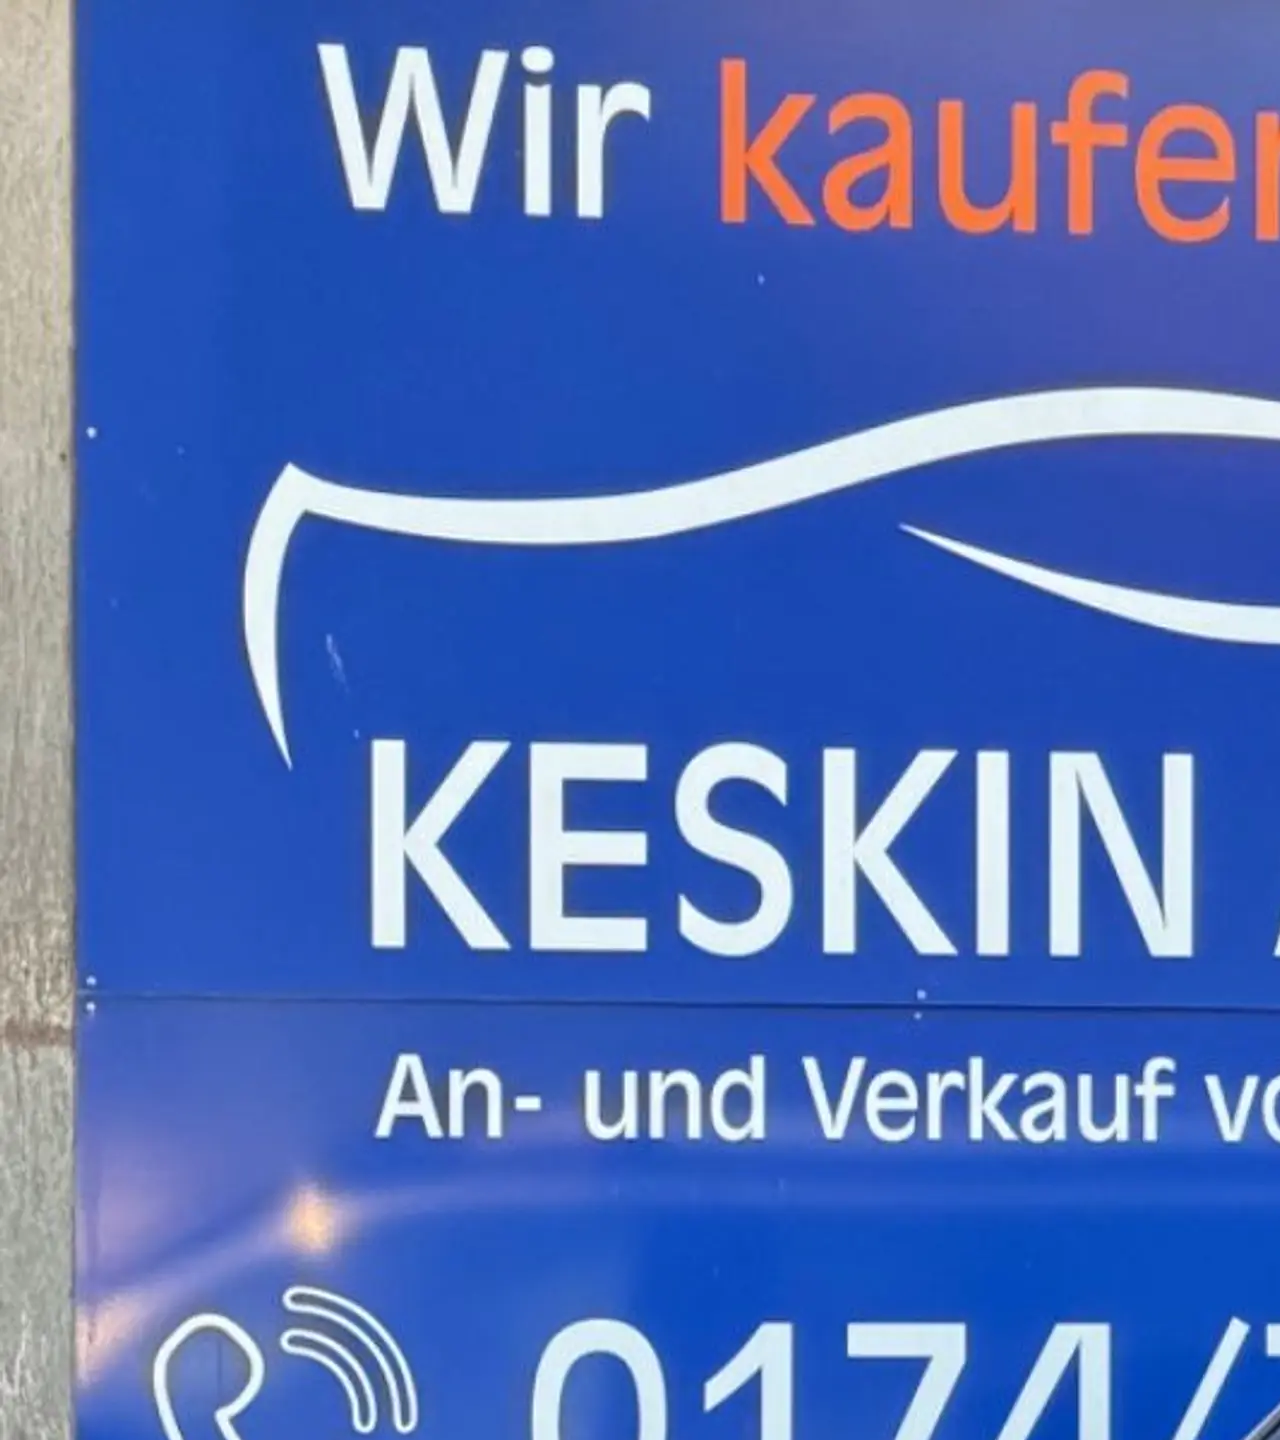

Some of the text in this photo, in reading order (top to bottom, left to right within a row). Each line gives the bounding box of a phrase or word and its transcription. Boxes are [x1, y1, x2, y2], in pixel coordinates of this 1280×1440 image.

[318, 44, 650, 218] Wir
[371, 739, 1194, 958] KESKIN
[376, 1054, 541, 1139] An-
[585, 1055, 766, 1142] und
[801, 1056, 1175, 1143] Verkauf
